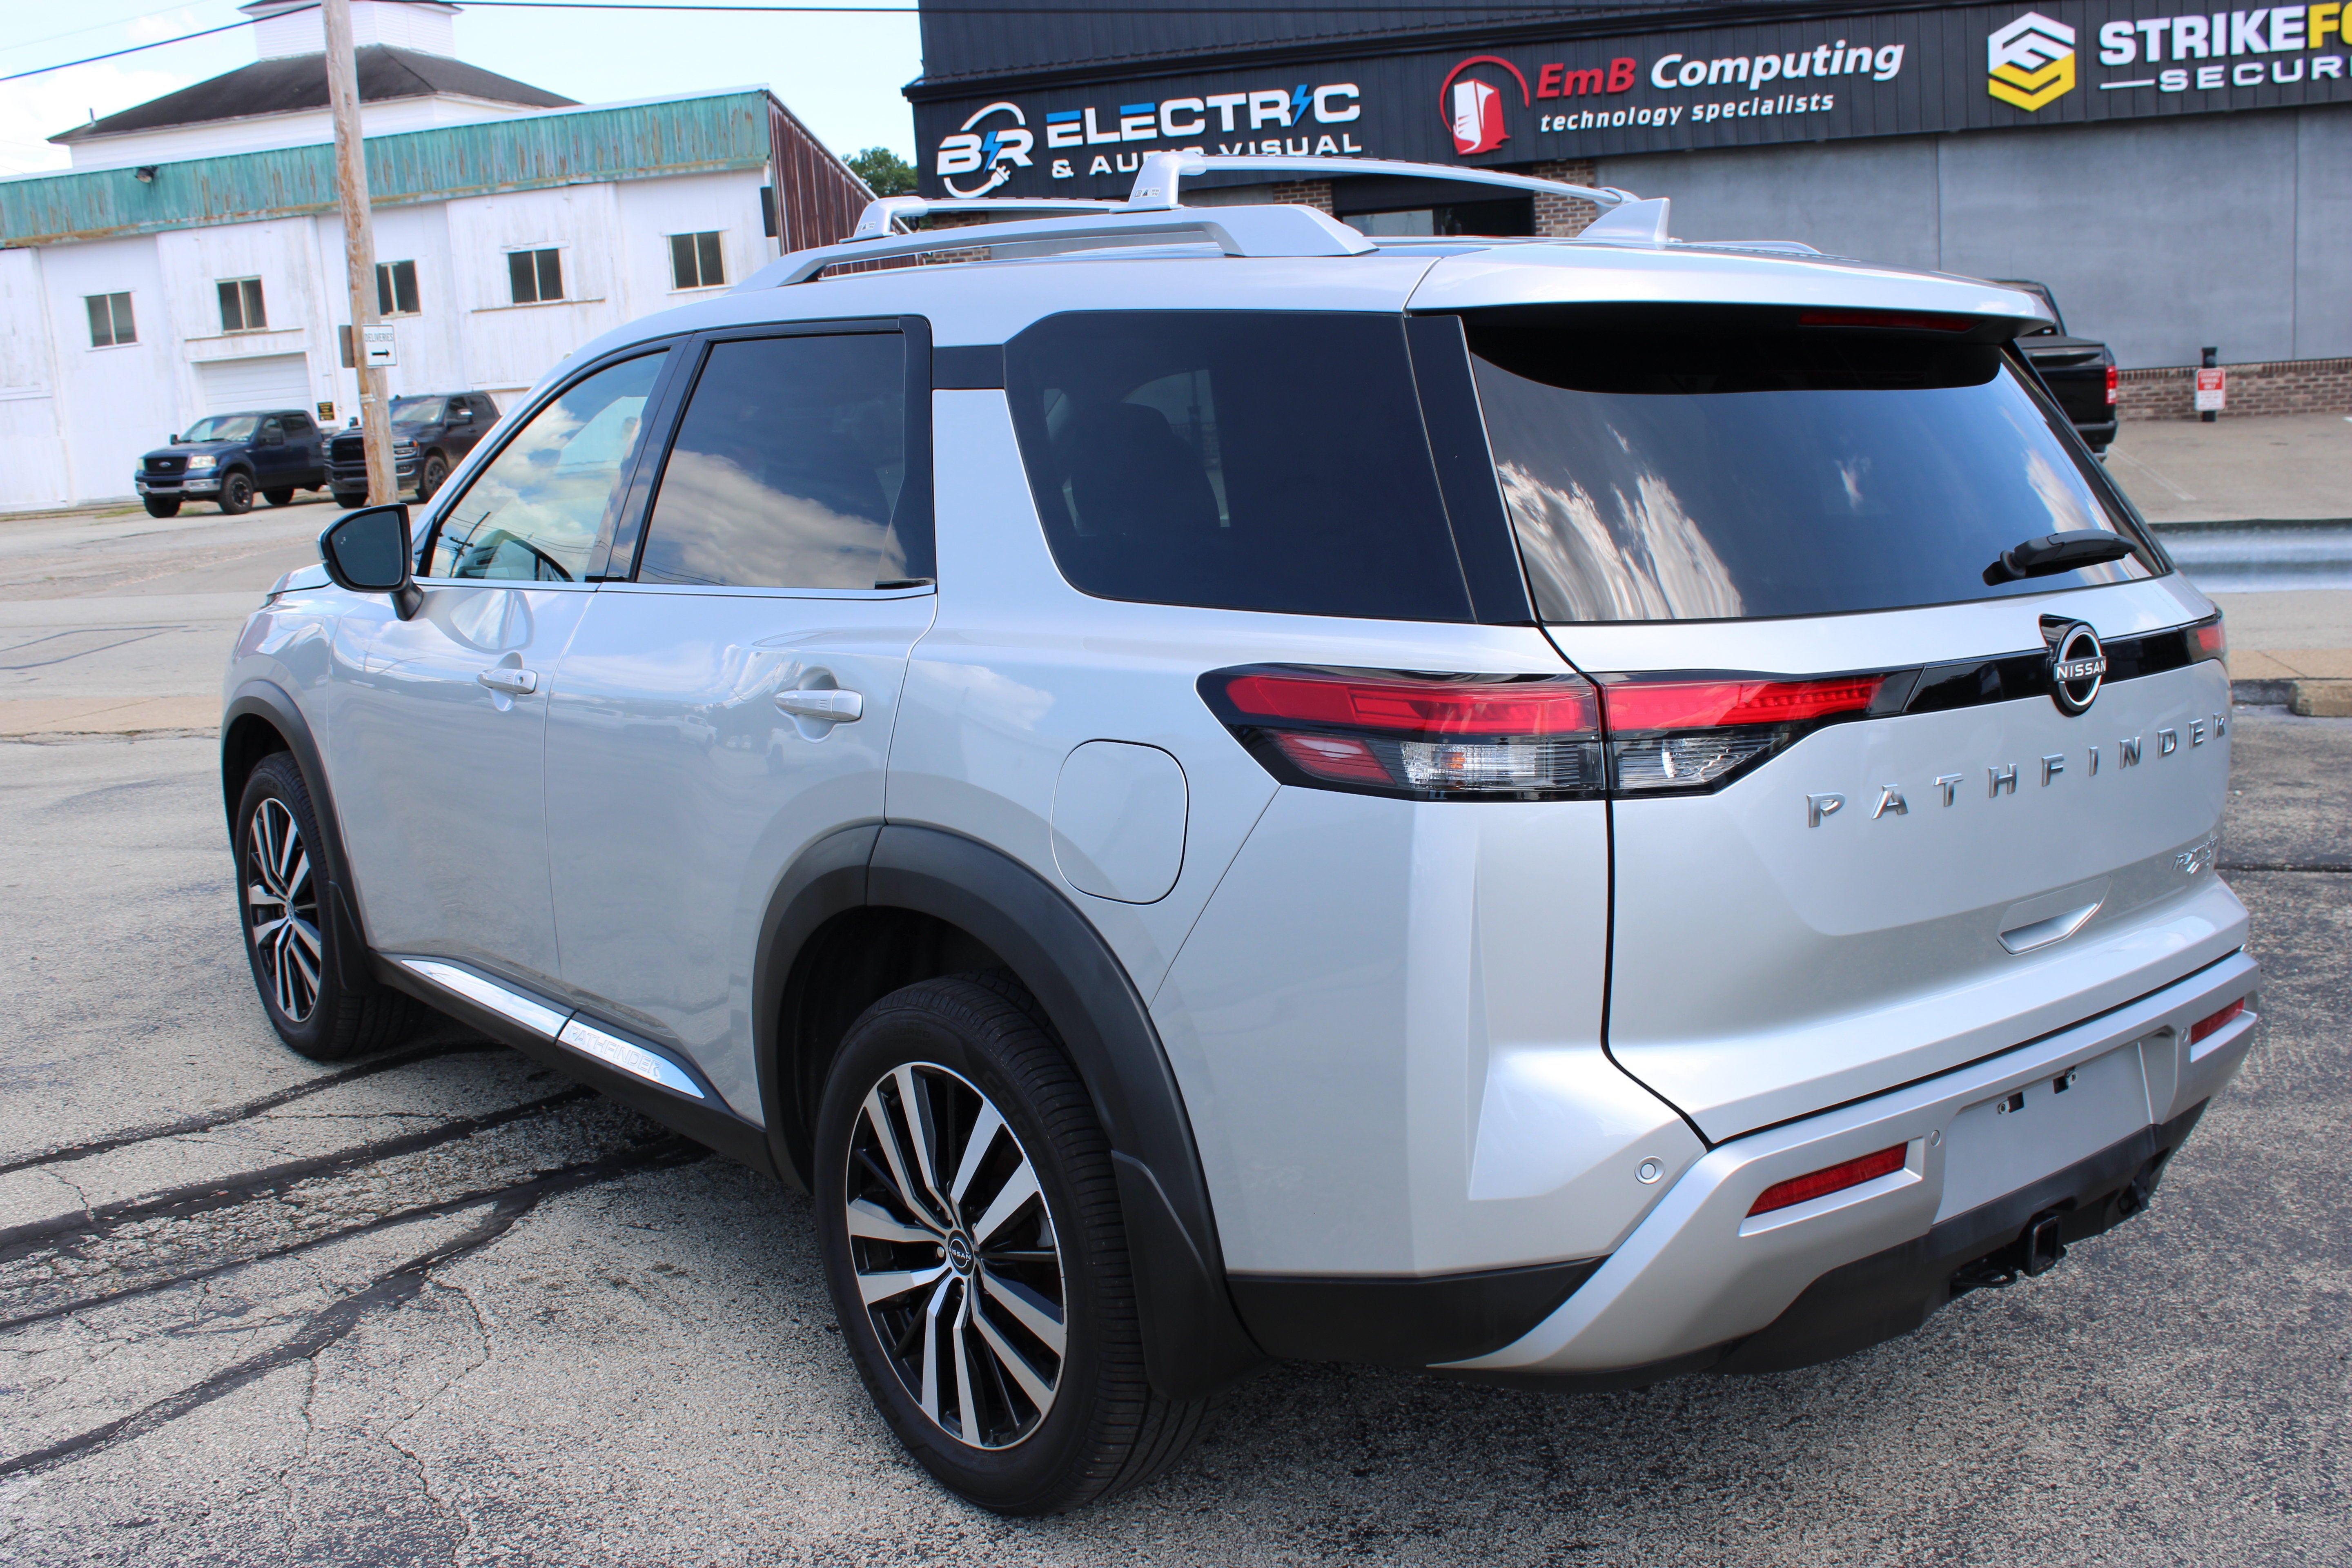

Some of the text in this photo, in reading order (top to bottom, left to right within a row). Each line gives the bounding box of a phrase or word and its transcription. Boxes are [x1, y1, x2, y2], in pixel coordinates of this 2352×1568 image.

[2099, 1, 2352, 66] STRIKEF
[1537, 40, 1904, 98] EmB Computing
[2159, 53, 2352, 92] SECUR
[1046, 83, 1361, 149] ELECTRIC
[1541, 94, 1834, 132] technology specialists
[1051, 159, 1074, 179] &
[1218, 134, 1362, 156] VISUAL
[365, 333, 394, 342] DELIVERIES
[2056, 659, 2107, 679] NISSAN
[1806, 711, 2226, 828] PATHFINDER
[567, 1025, 662, 1078] PATHFINDER
[948, 1246, 971, 1260] NISSAN
